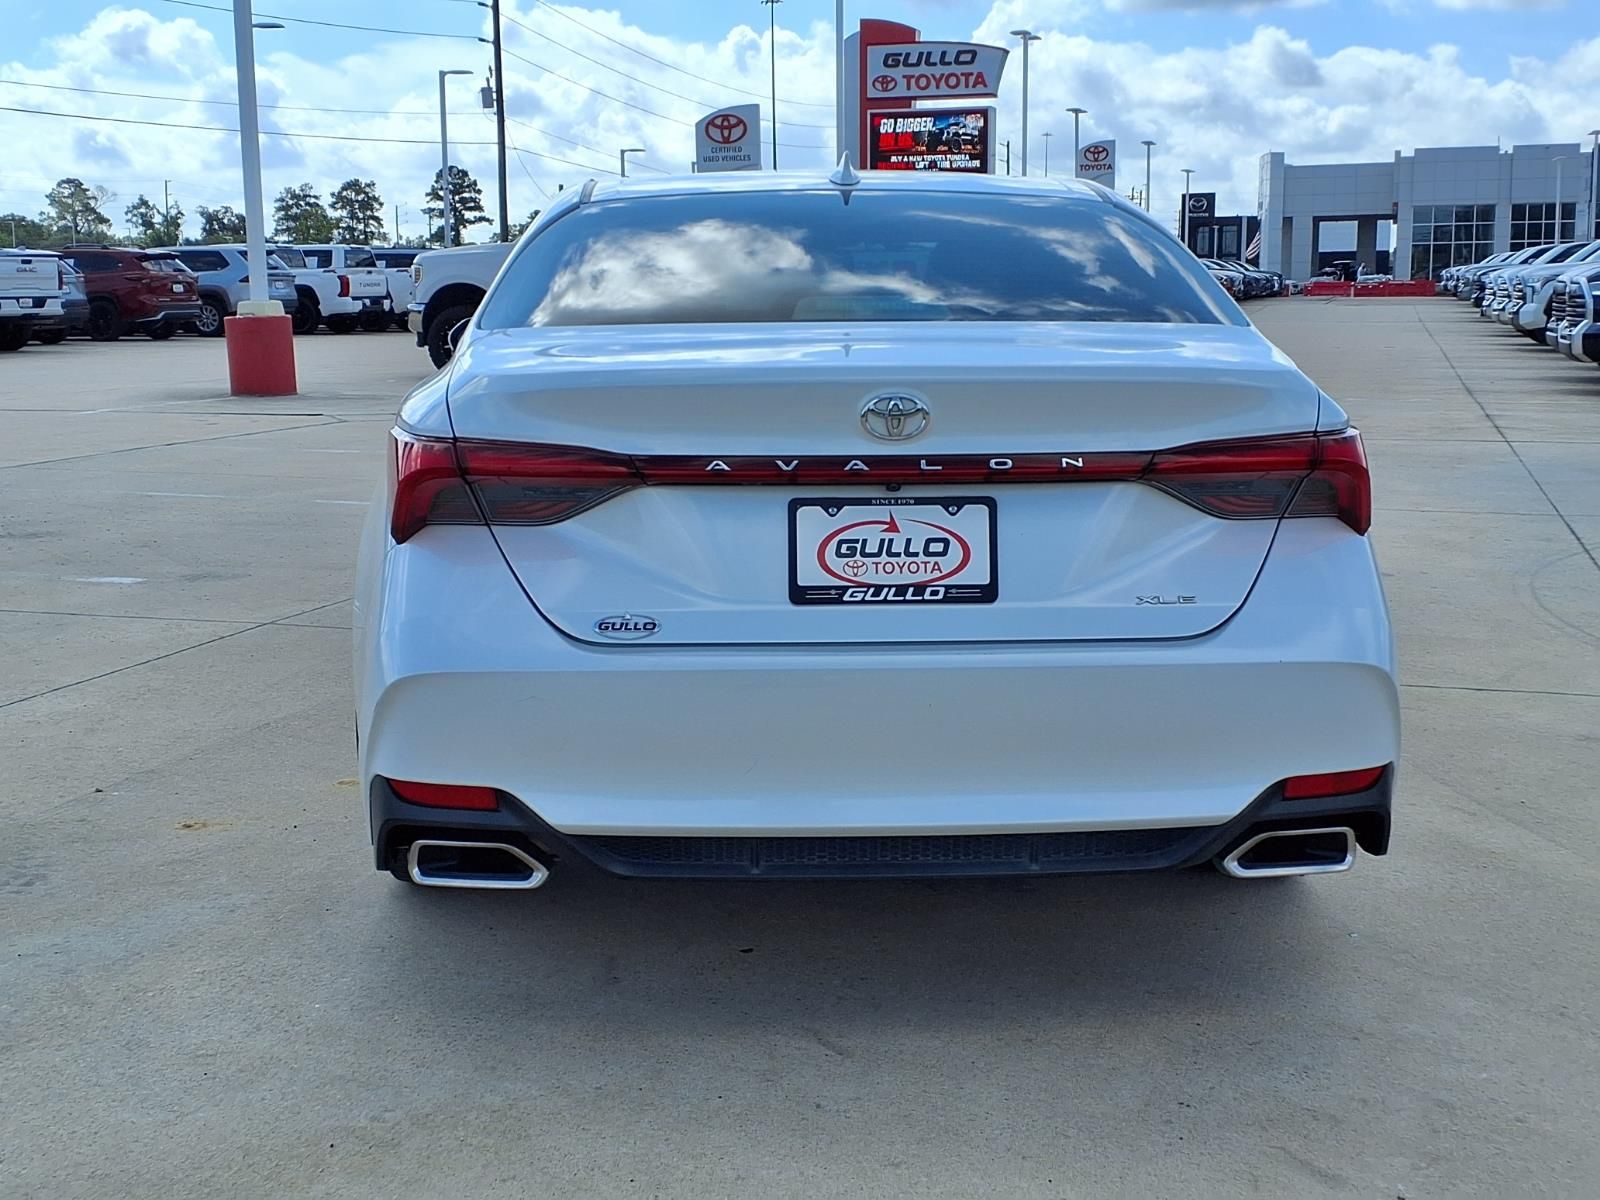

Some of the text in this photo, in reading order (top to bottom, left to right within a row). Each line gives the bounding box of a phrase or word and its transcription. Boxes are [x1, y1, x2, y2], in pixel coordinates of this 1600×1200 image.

[882, 49, 978, 68] GULLO
[902, 71, 988, 91] TOYOTA
[880, 118, 895, 134] GO
[710, 146, 743, 154] CERTIFIED
[703, 154, 752, 163] USED VEHICLES
[1080, 163, 1113, 172] TOYOTA
[704, 457, 1084, 471] AVALON
[834, 537, 951, 559] GULLO
[872, 561, 943, 575] TOYOTA
[842, 586, 946, 602] GULLO
[1135, 595, 1198, 606] XLE
[598, 621, 657, 631] GULLO
